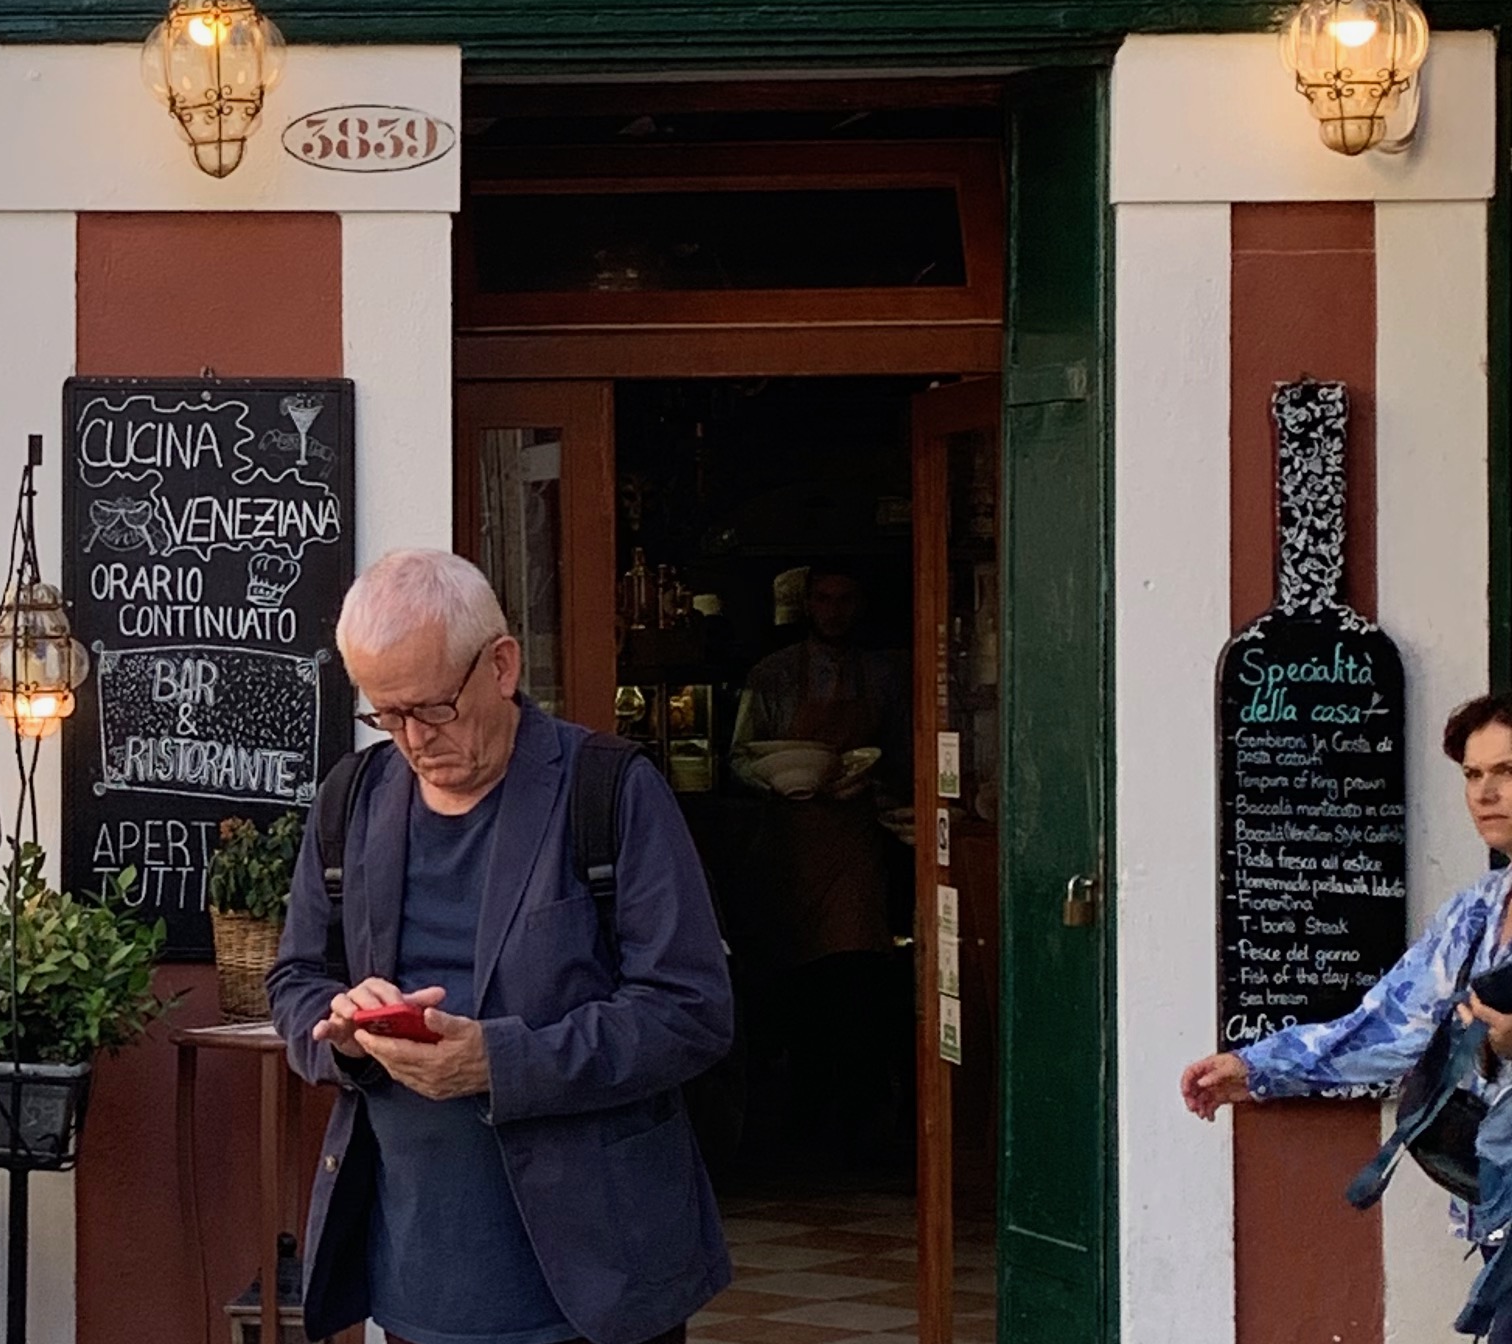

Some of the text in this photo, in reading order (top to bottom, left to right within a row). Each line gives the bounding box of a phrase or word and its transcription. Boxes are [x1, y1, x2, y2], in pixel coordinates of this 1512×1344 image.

[302, 117, 438, 160] 3839
[82, 419, 223, 470] CUCINA
[161, 495, 340, 544] VENEZIANA
[91, 562, 202, 603] ORARIO
[118, 604, 296, 643] CONTINUATO
[151, 658, 218, 706] BAR
[1239, 642, 1375, 699] Specialità
[177, 701, 199, 737] &
[1240, 687, 1361, 724] della casa
[118, 736, 300, 794] RISTORANTE
[1293, 769, 1309, 789] of
[93, 820, 216, 866] APERT
[1237, 843, 1274, 868] Pasta
[93, 867, 207, 912] TUTTI
[1305, 916, 1349, 935] Steak
[1286, 942, 1309, 961] del
[1273, 964, 1291, 985] of
[1296, 967, 1319, 985] the
